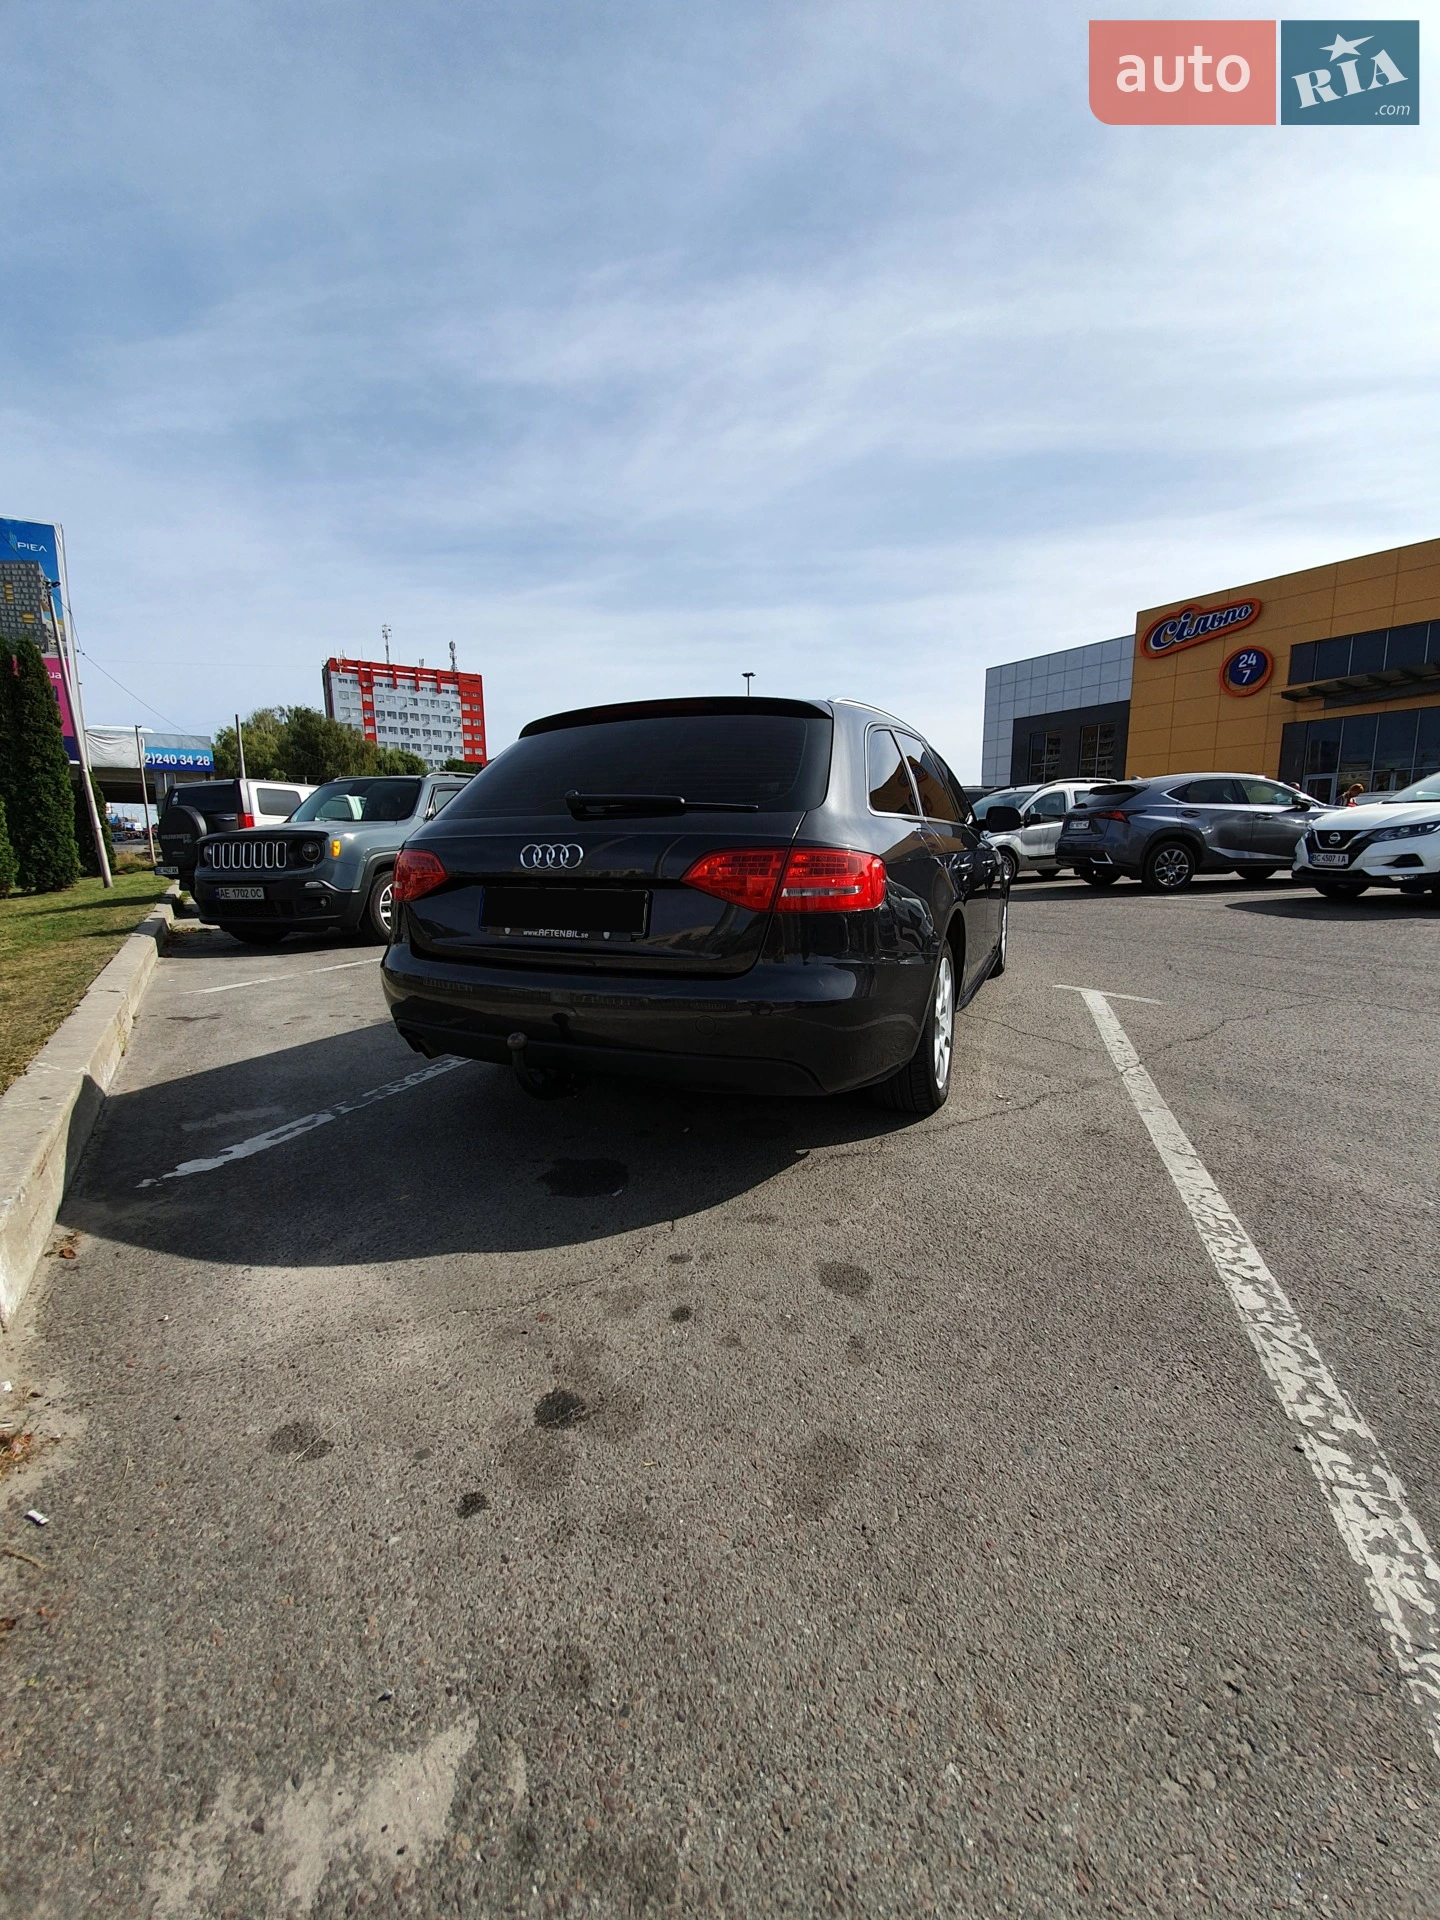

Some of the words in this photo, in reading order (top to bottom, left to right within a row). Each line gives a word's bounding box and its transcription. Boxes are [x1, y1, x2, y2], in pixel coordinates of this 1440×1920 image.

[1150, 604, 1252, 650] Сільпо
[1238, 652, 1257, 668] 24
[1242, 670, 1250, 683] 7
[180, 754, 194, 765] 34
[196, 755, 210, 766] 28
[220, 888, 231, 899] AE
[232, 888, 249, 899] 1702
[250, 888, 263, 899] OC
